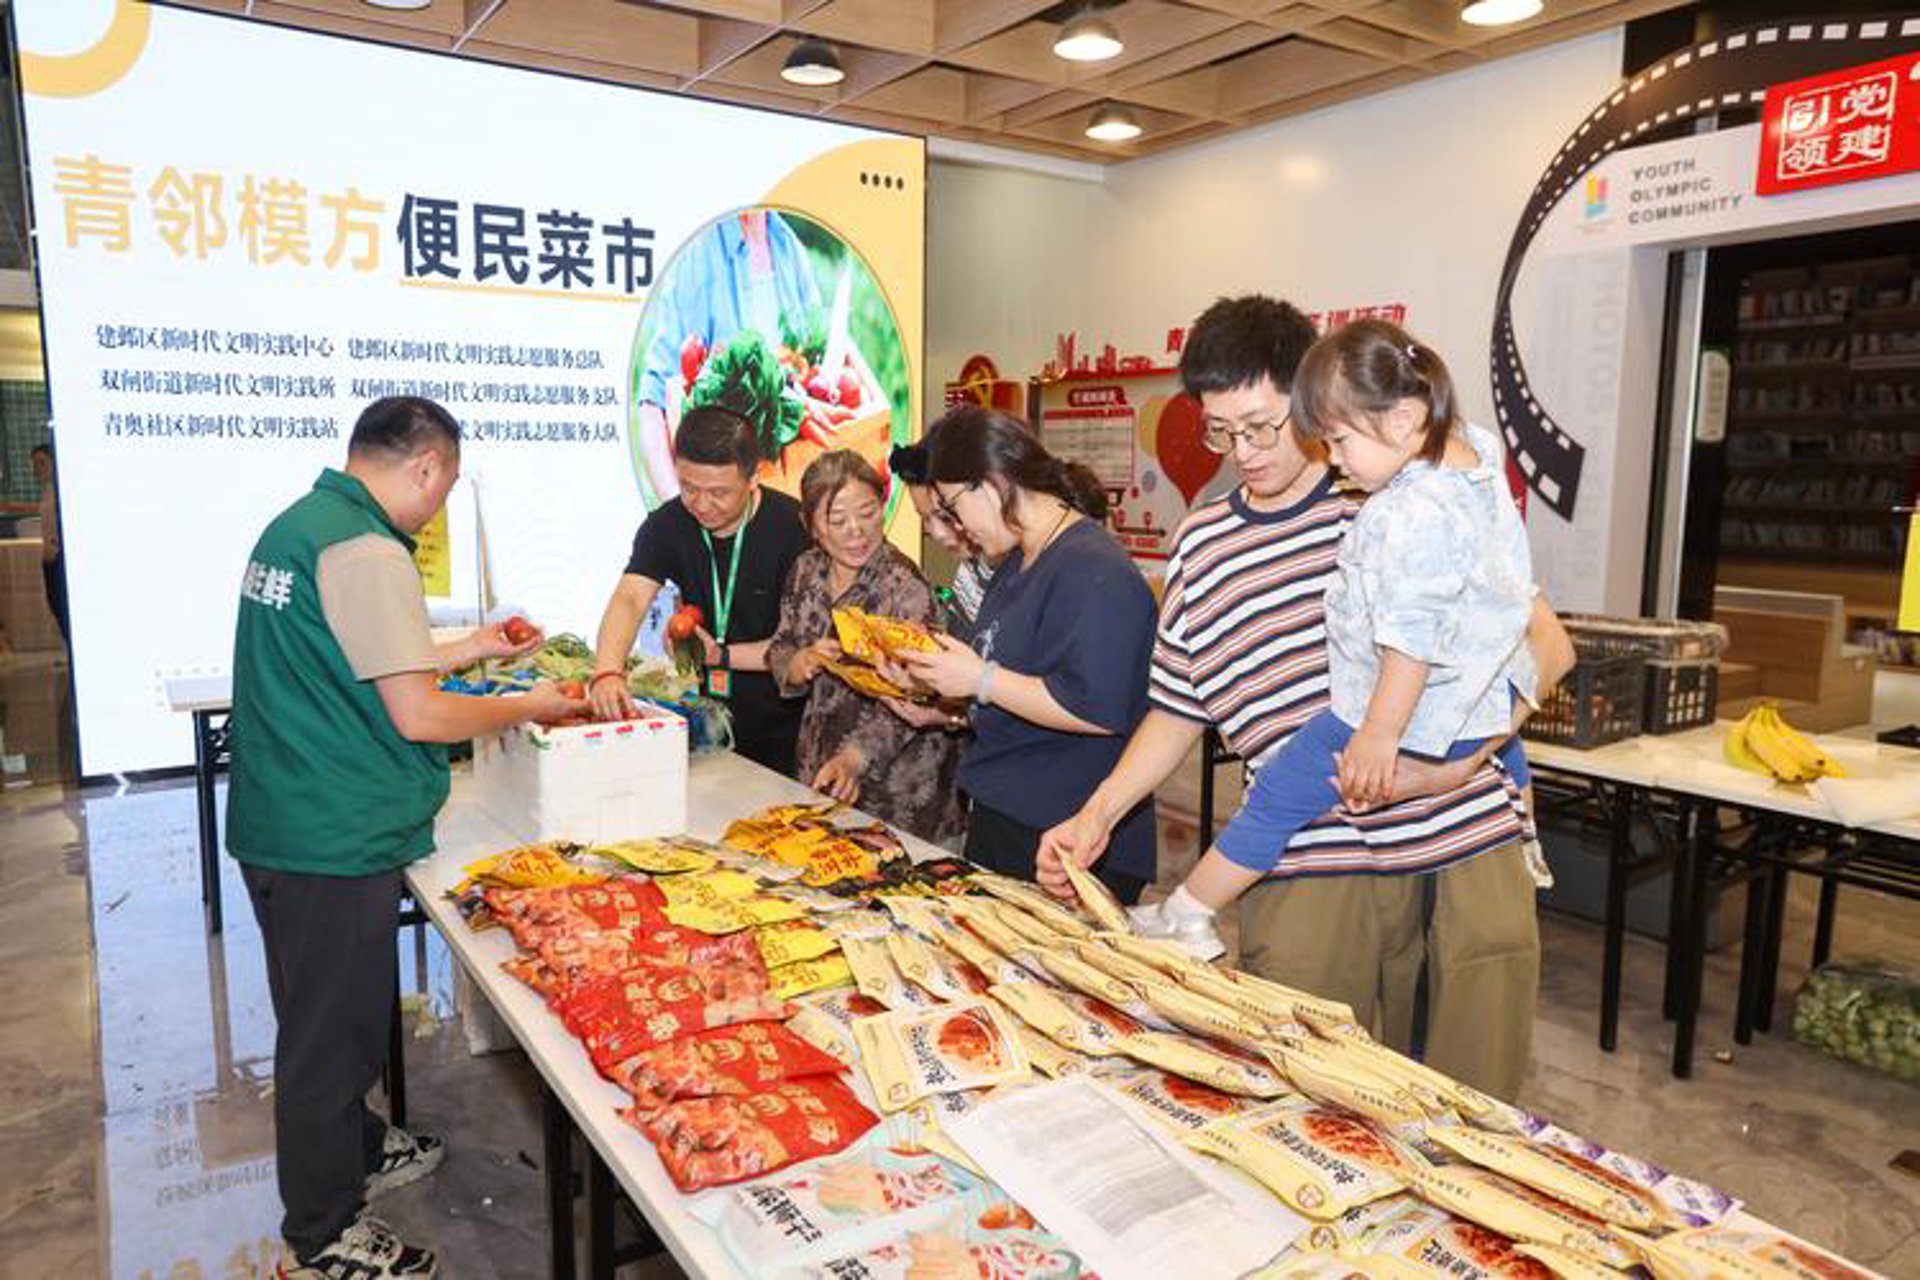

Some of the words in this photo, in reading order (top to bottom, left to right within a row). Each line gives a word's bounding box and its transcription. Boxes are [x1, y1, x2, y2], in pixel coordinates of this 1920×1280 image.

[1633, 159, 1696, 182] YOUTH
[1630, 178, 1712, 204] OLYMPIC
[1628, 194, 1742, 224] COMMUNITY
[51, 153, 386, 272] 青邻模方
[397, 193, 655, 294] 便民菜市
[104, 412, 340, 439] 青奥社区新时代文明实践站
